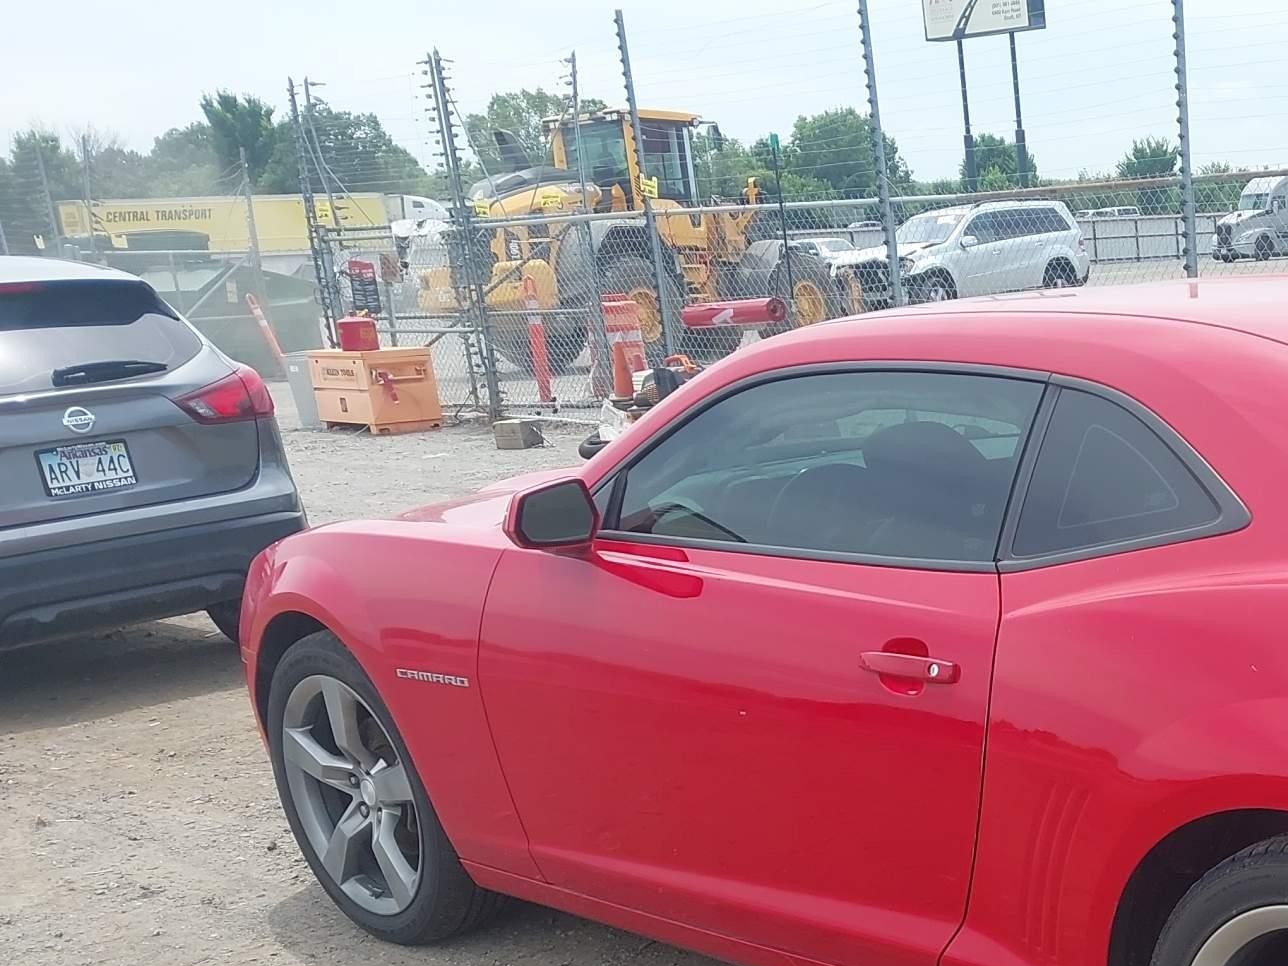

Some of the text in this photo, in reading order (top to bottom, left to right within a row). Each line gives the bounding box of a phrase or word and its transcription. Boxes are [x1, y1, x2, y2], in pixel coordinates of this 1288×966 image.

[105, 208, 212, 223] CENTRAL TRANSPORT
[60, 446, 108, 461] Arkansas
[47, 454, 130, 485] ARV 44C
[51, 477, 136, 496] McLARTY NISSAN
[395, 668, 469, 688] CAMARO
